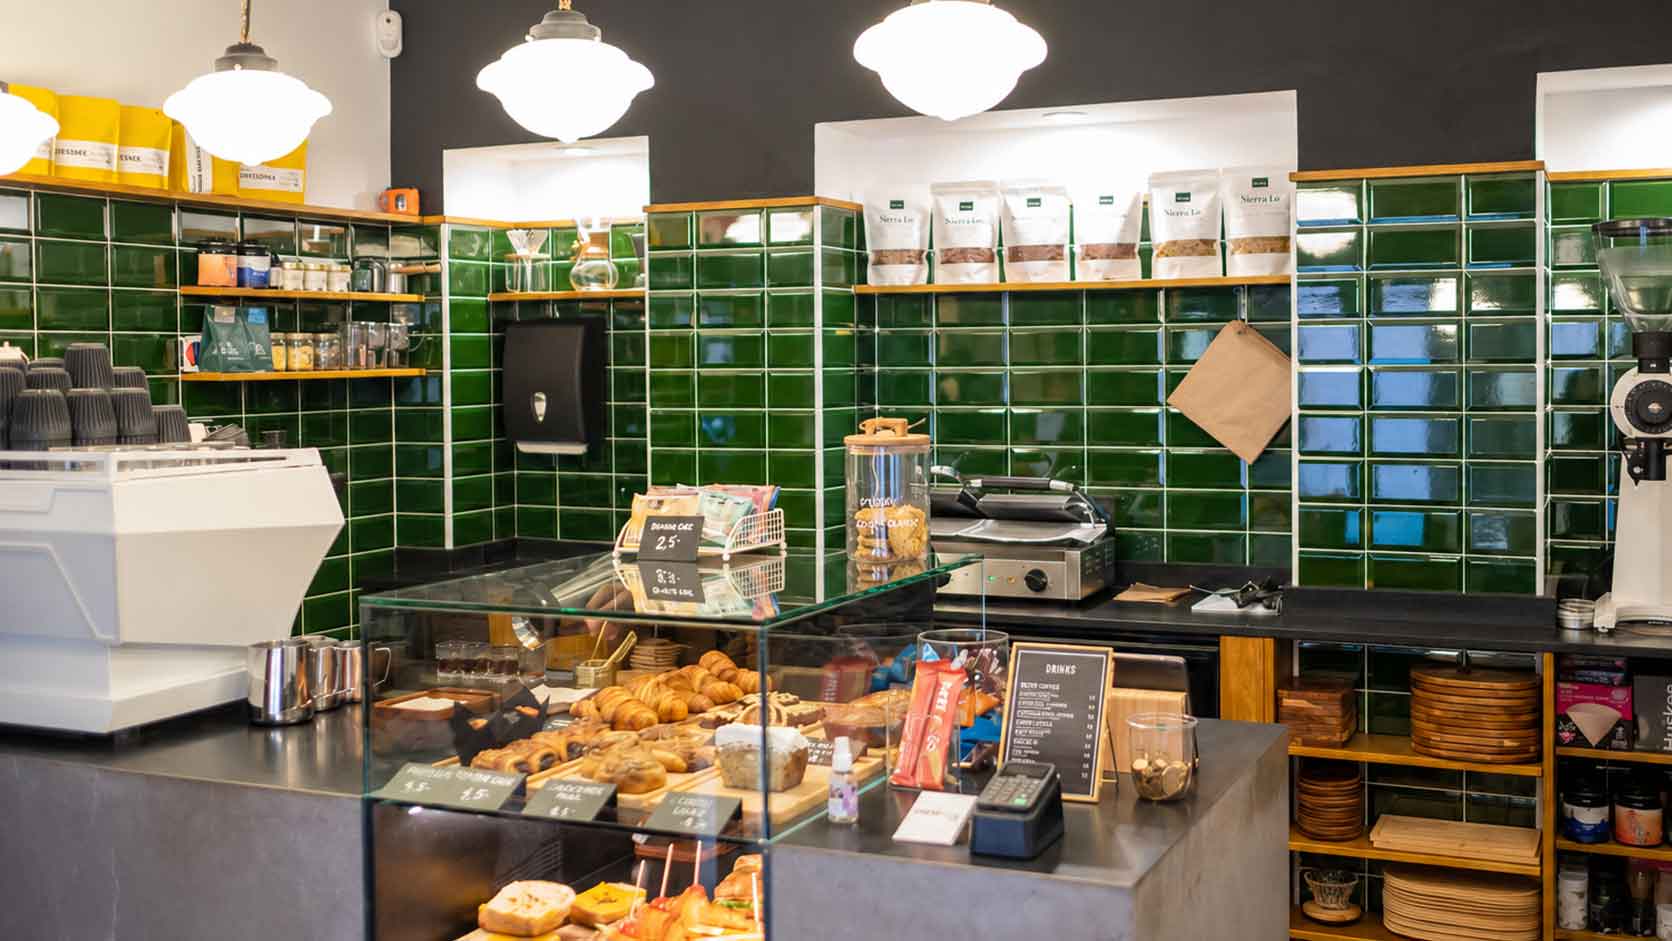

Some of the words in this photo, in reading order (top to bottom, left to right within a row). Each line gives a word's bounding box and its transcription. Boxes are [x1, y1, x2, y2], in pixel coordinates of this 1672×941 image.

[1240, 193, 1268, 204] Sierra
[1163, 208, 1189, 218] Sierra
[1046, 664, 1077, 675] DRINKS
